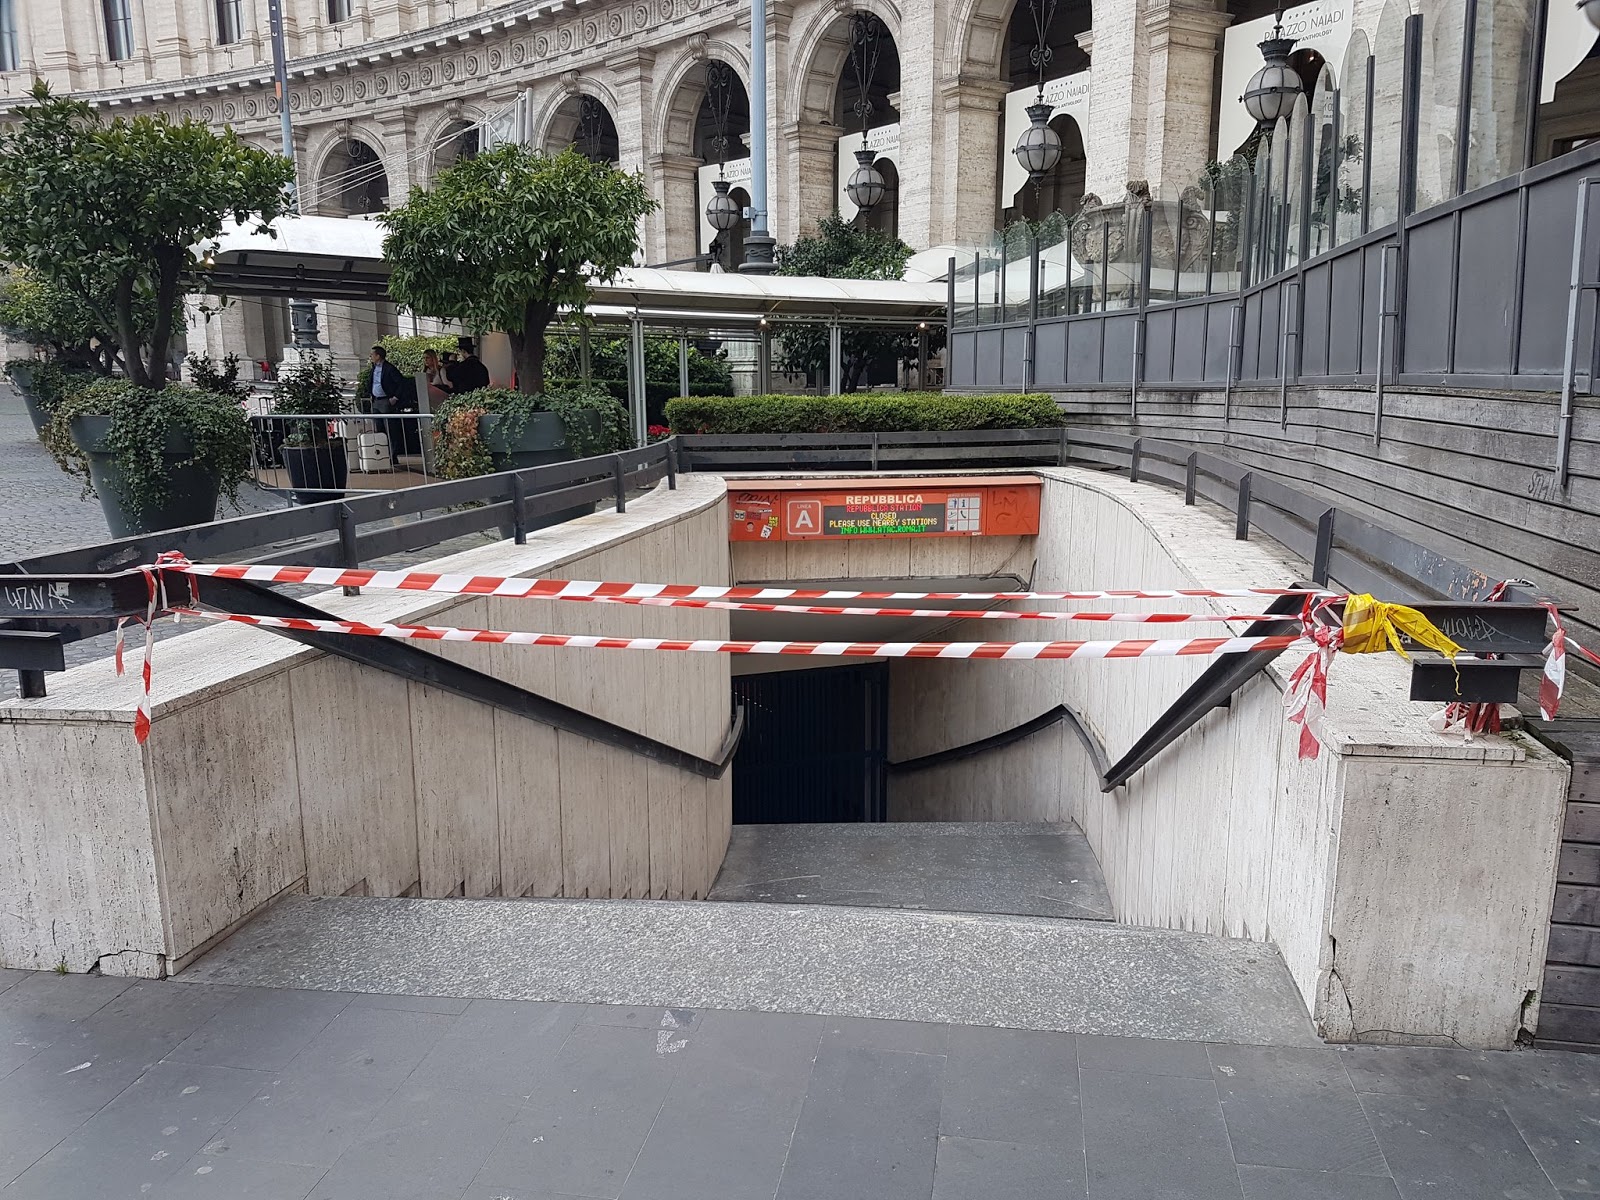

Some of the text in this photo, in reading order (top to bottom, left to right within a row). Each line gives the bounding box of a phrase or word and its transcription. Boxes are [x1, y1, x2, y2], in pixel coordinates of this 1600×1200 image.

[1264, 9, 1344, 40] PAAZZO NAIADI
[1302, 29, 1333, 42] ANTHOLOGY
[1067, 83, 1089, 98] NAIADI
[846, 495, 923, 504] REPUBBLICA
[846, 504, 888, 512] REPUBBLICA
[795, 510, 814, 529] A
[829, 518, 938, 528] PLEASE USE NEARBY STATIONS
[840, 526, 858, 534] INFO
